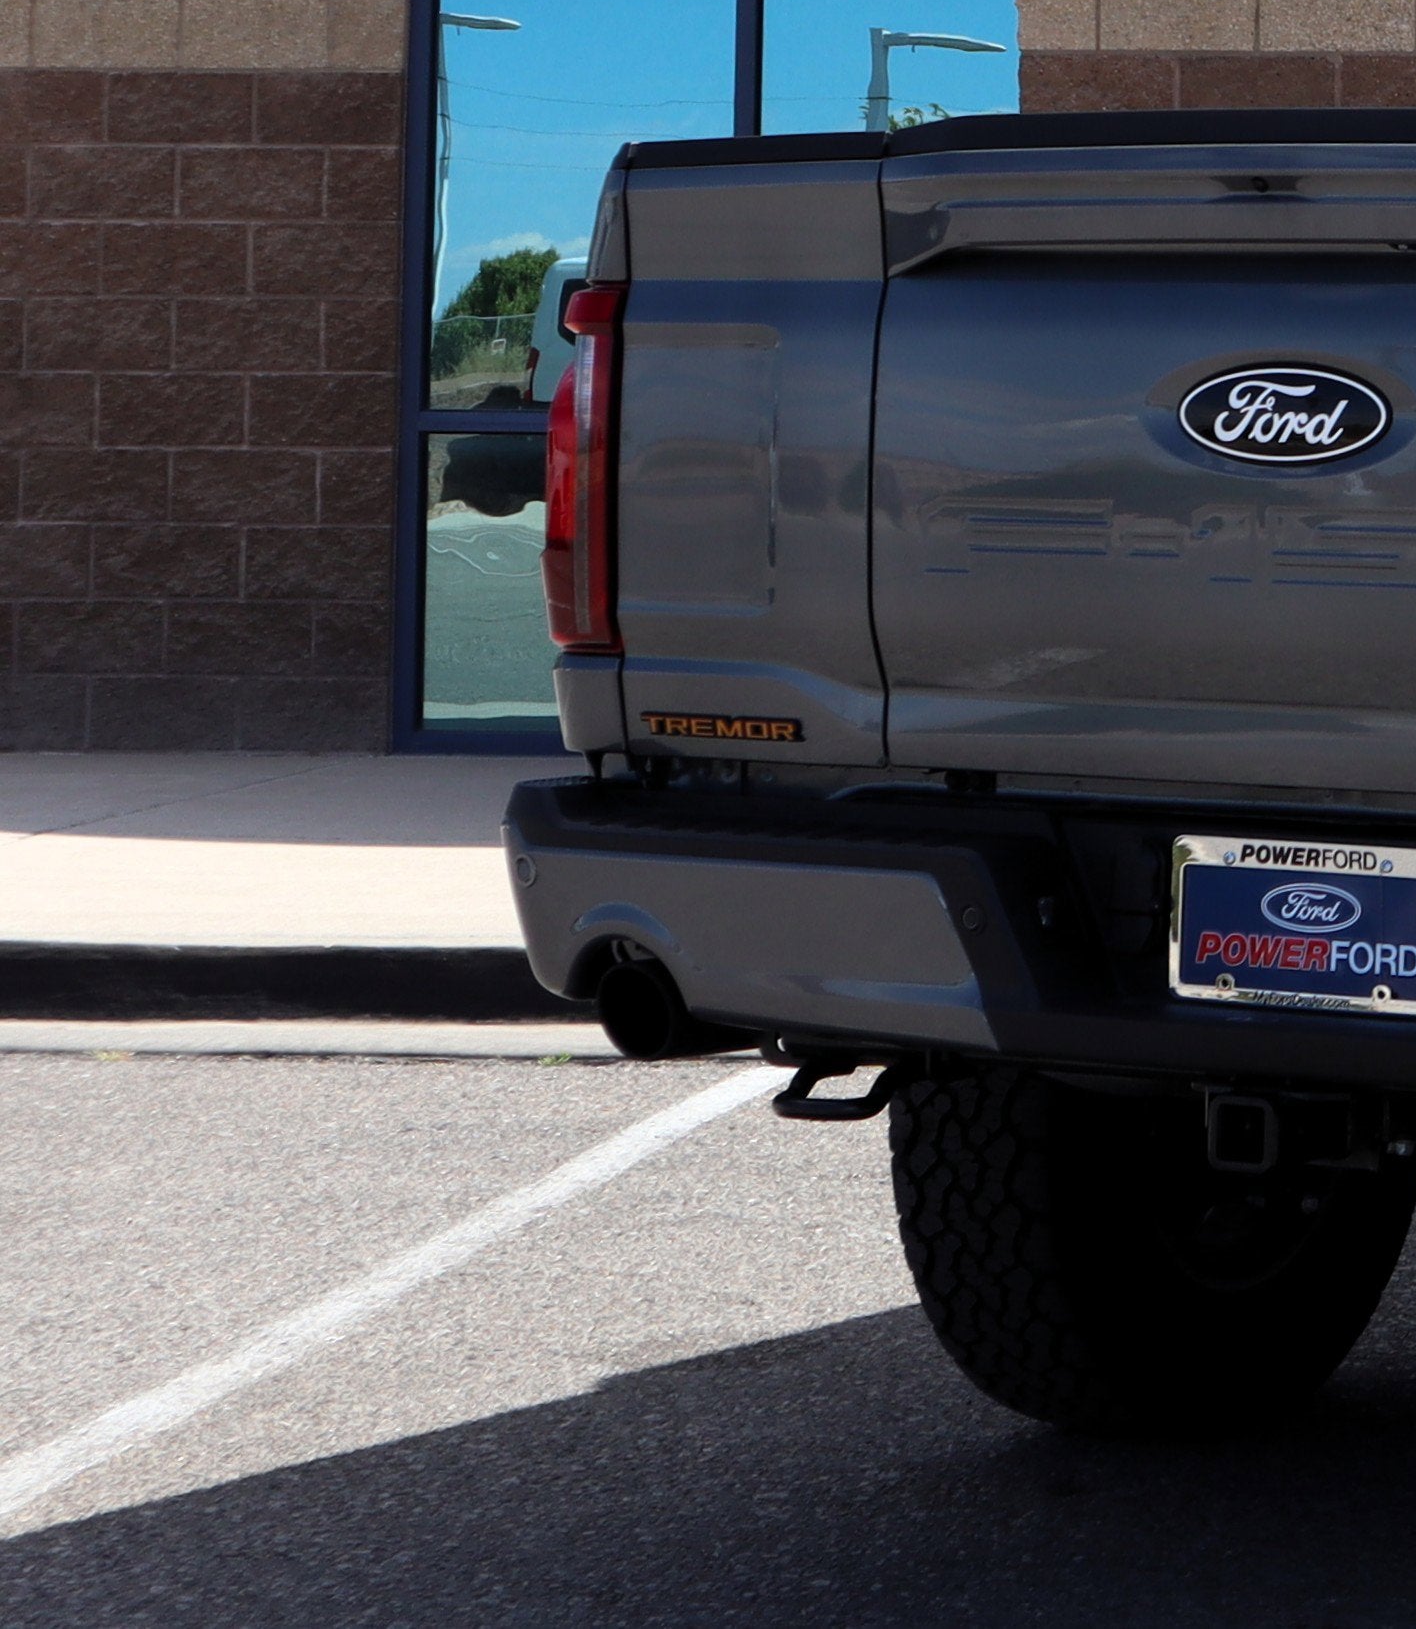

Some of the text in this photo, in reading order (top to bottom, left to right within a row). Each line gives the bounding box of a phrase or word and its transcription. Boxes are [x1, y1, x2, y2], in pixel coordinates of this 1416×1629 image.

[1213, 380, 1349, 446] Ford
[641, 712, 803, 742] TREMOR
[1240, 844, 1378, 870] POWERFORD
[1280, 890, 1340, 922] Ford
